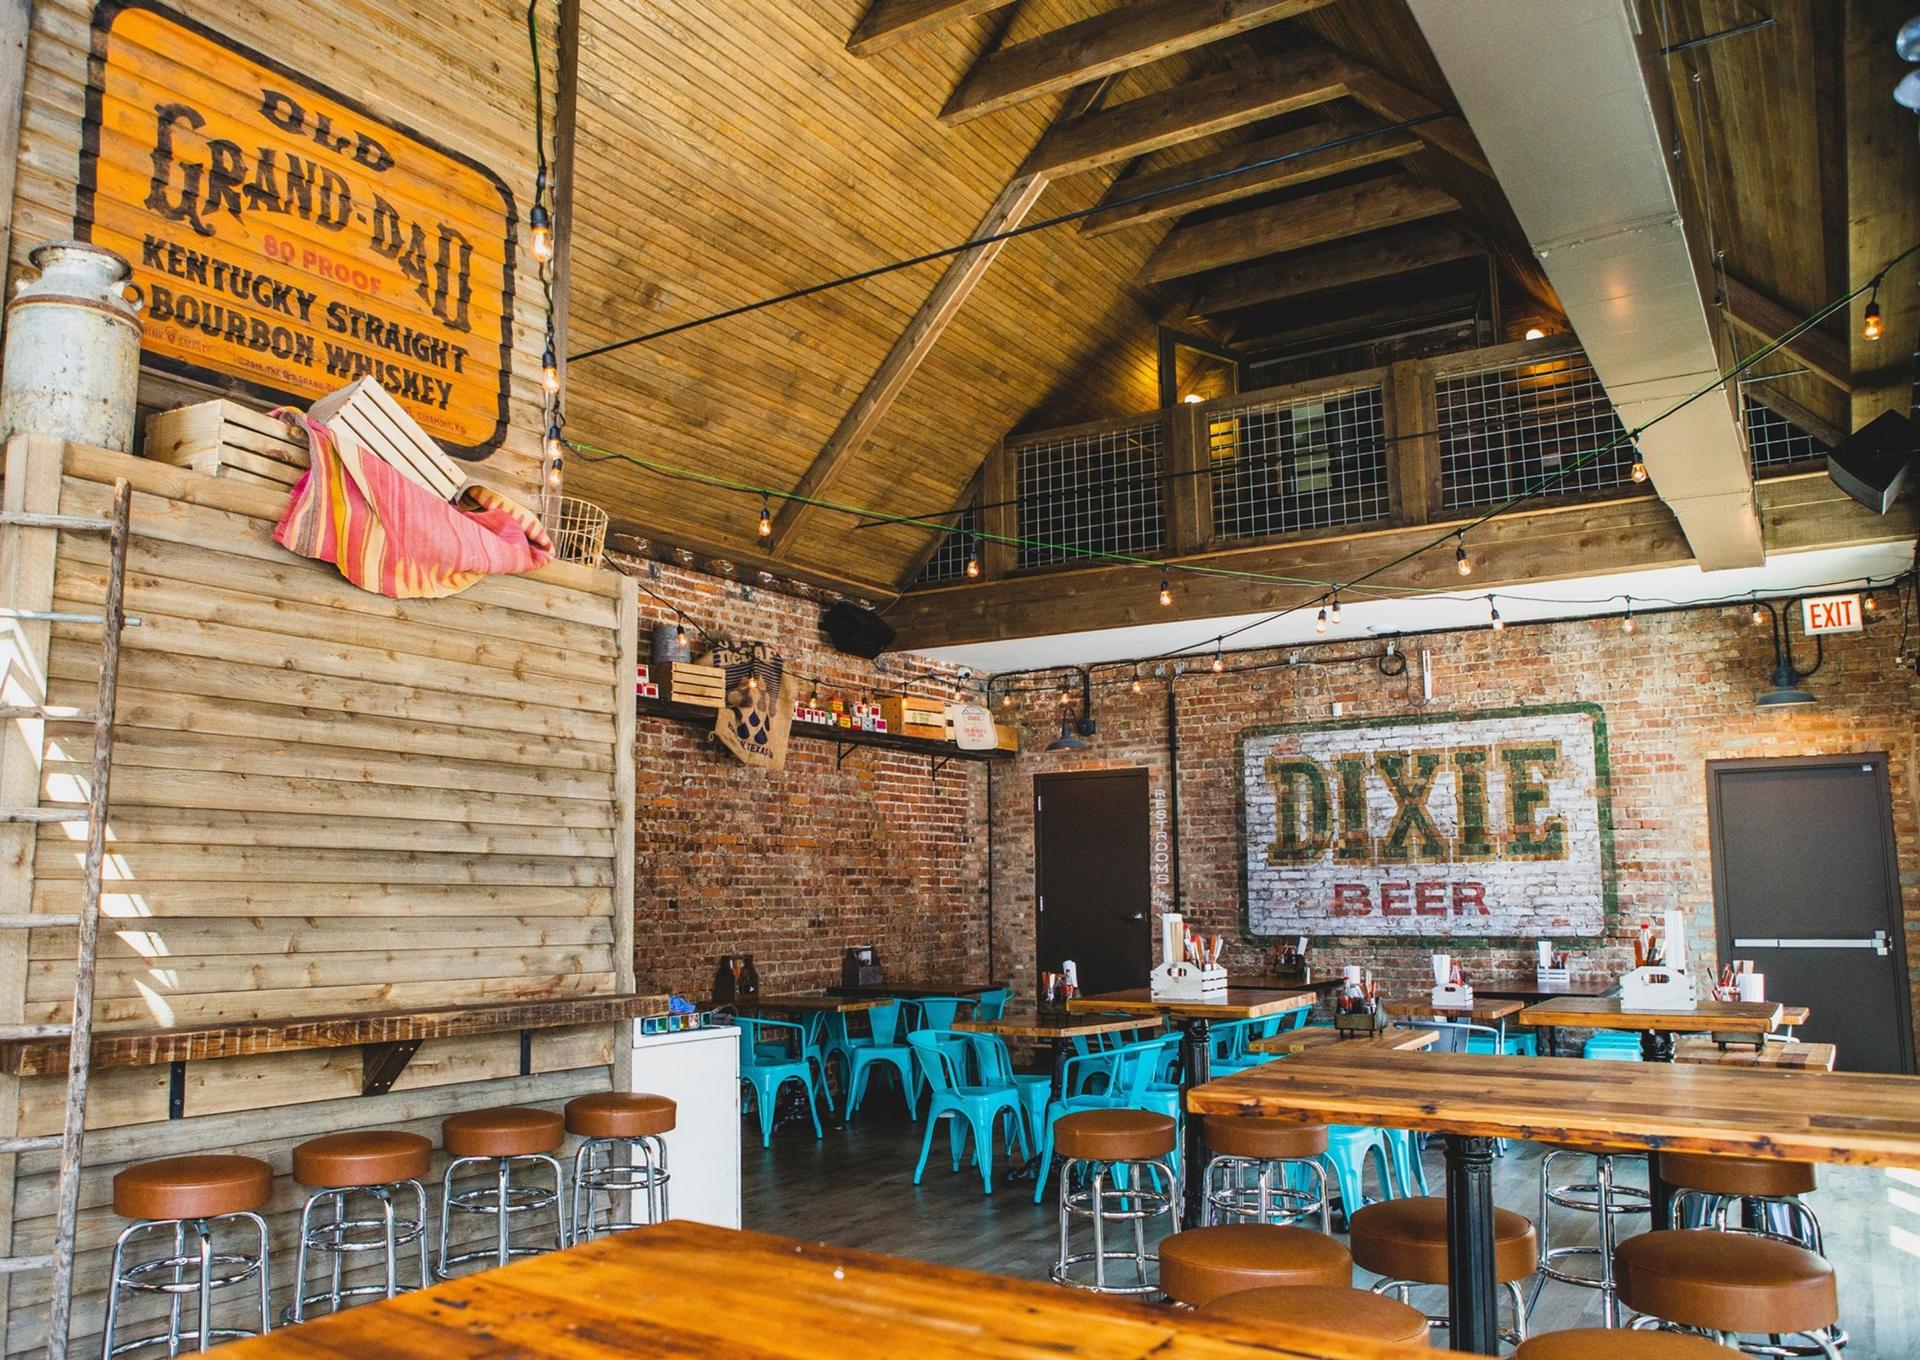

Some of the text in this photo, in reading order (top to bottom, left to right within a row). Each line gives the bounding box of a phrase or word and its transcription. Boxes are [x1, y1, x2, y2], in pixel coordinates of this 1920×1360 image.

[259, 88, 396, 173] OLD
[144, 103, 474, 334] GRAND-DAD
[263, 234, 382, 296] 80 PROOF
[142, 232, 470, 375] KENTUCKY STRAIGHT
[148, 283, 454, 411] BOURBON WHISKEY
[1809, 600, 1853, 629] EXIT
[1154, 788, 1170, 885] RESTROOMS
[1263, 739, 1570, 868] DIXIE
[1332, 880, 1491, 918] BEER
